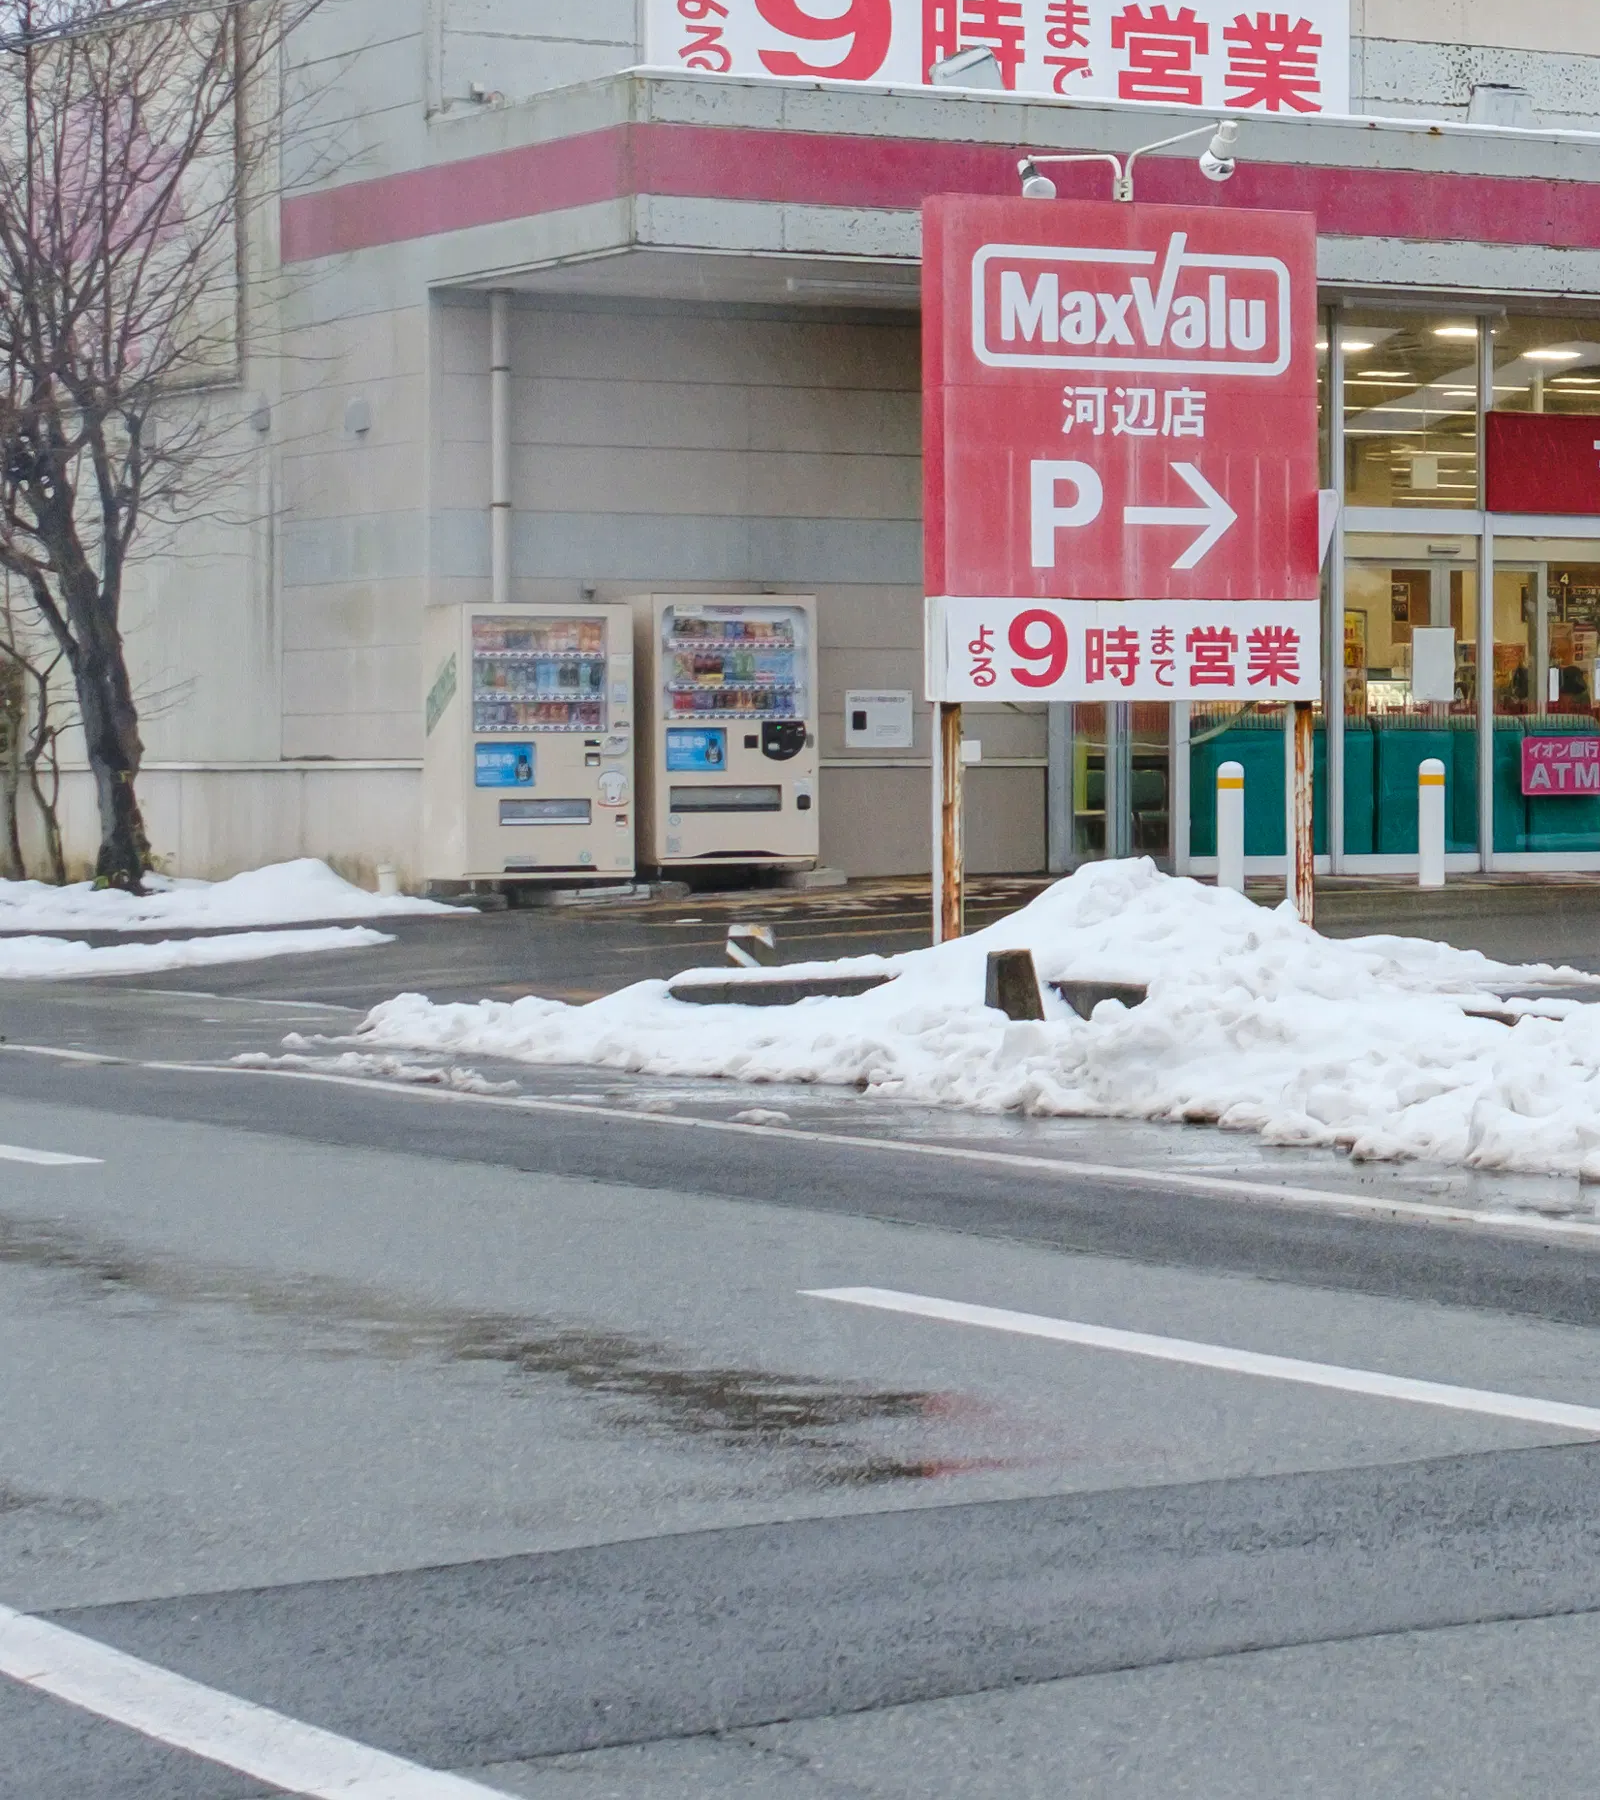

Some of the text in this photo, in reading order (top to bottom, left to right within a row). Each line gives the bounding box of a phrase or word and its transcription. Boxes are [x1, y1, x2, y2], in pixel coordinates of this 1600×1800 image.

[1001, 232, 1267, 351] MaxValu
[1061, 385, 1208, 438] 河辺店
[1030, 459, 1104, 568] P
[1529, 741, 1599, 758] イオン銀行
[1529, 762, 1600, 789] ATM
